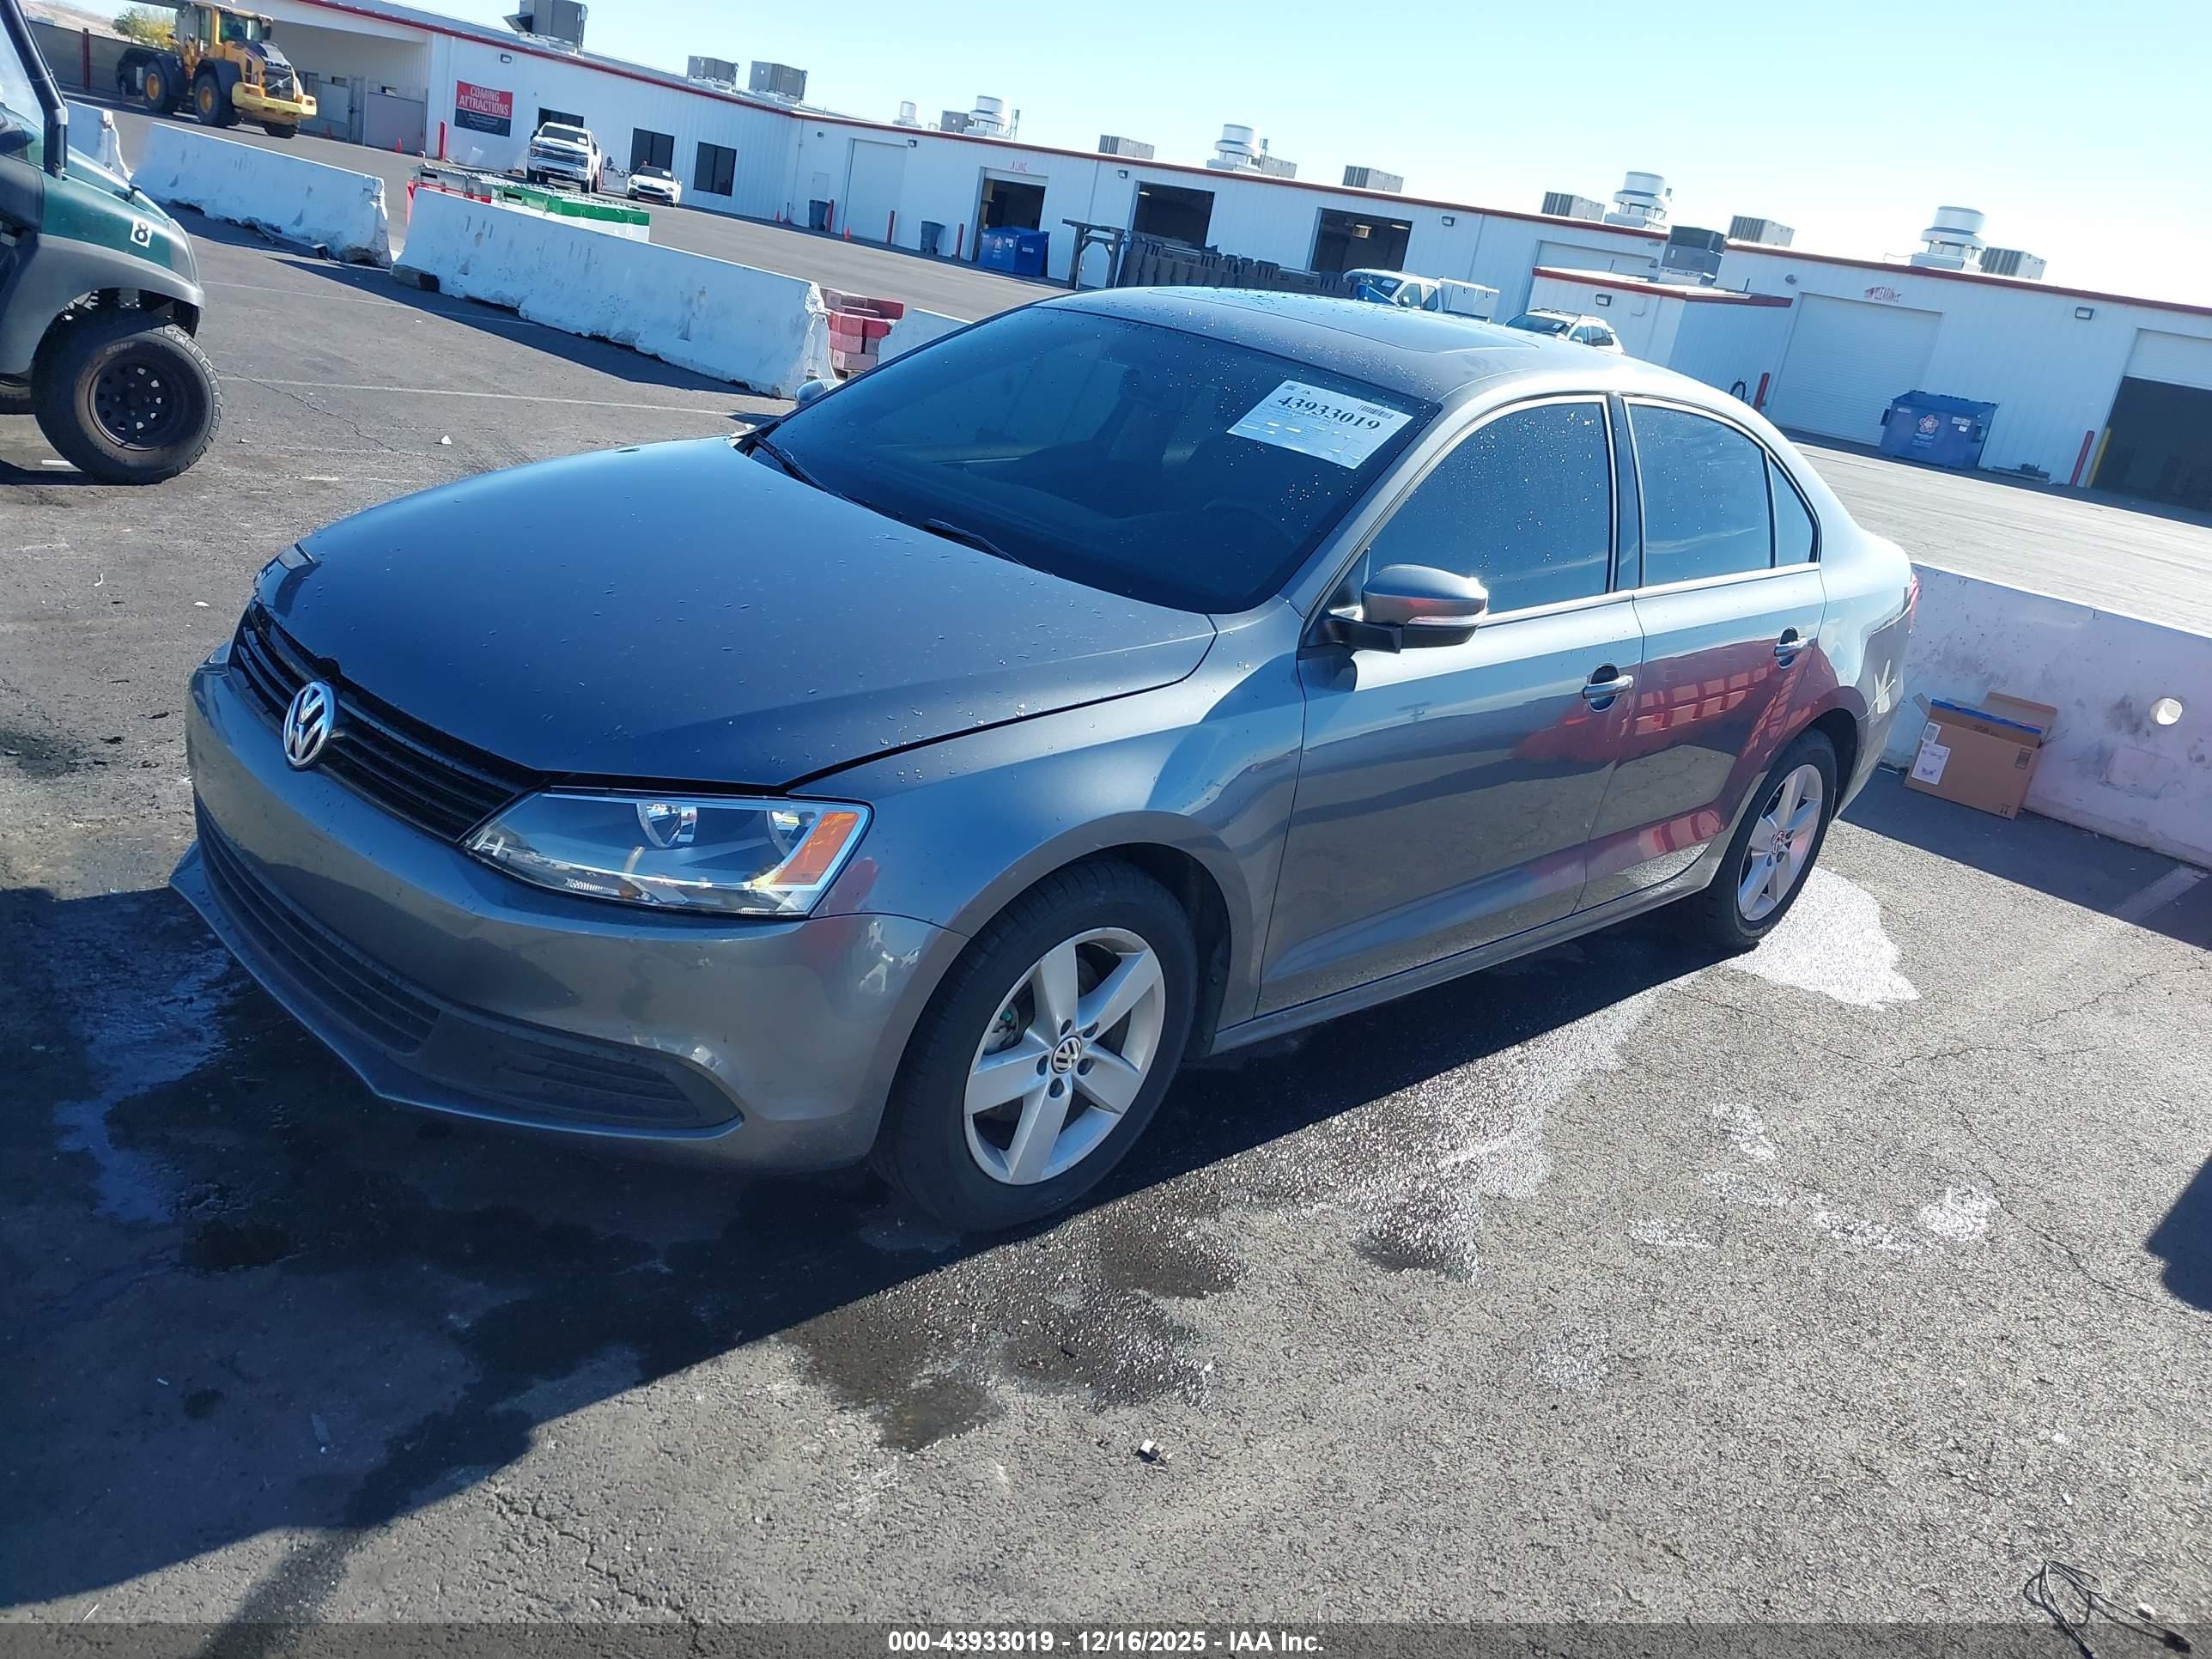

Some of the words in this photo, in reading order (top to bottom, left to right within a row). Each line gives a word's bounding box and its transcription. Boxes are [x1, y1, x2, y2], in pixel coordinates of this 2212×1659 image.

[470, 86, 501, 102] COMING
[459, 94, 509, 116] ATTRACTIONS
[134, 222, 149, 243] 8
[1277, 396, 1381, 430] 43933019
